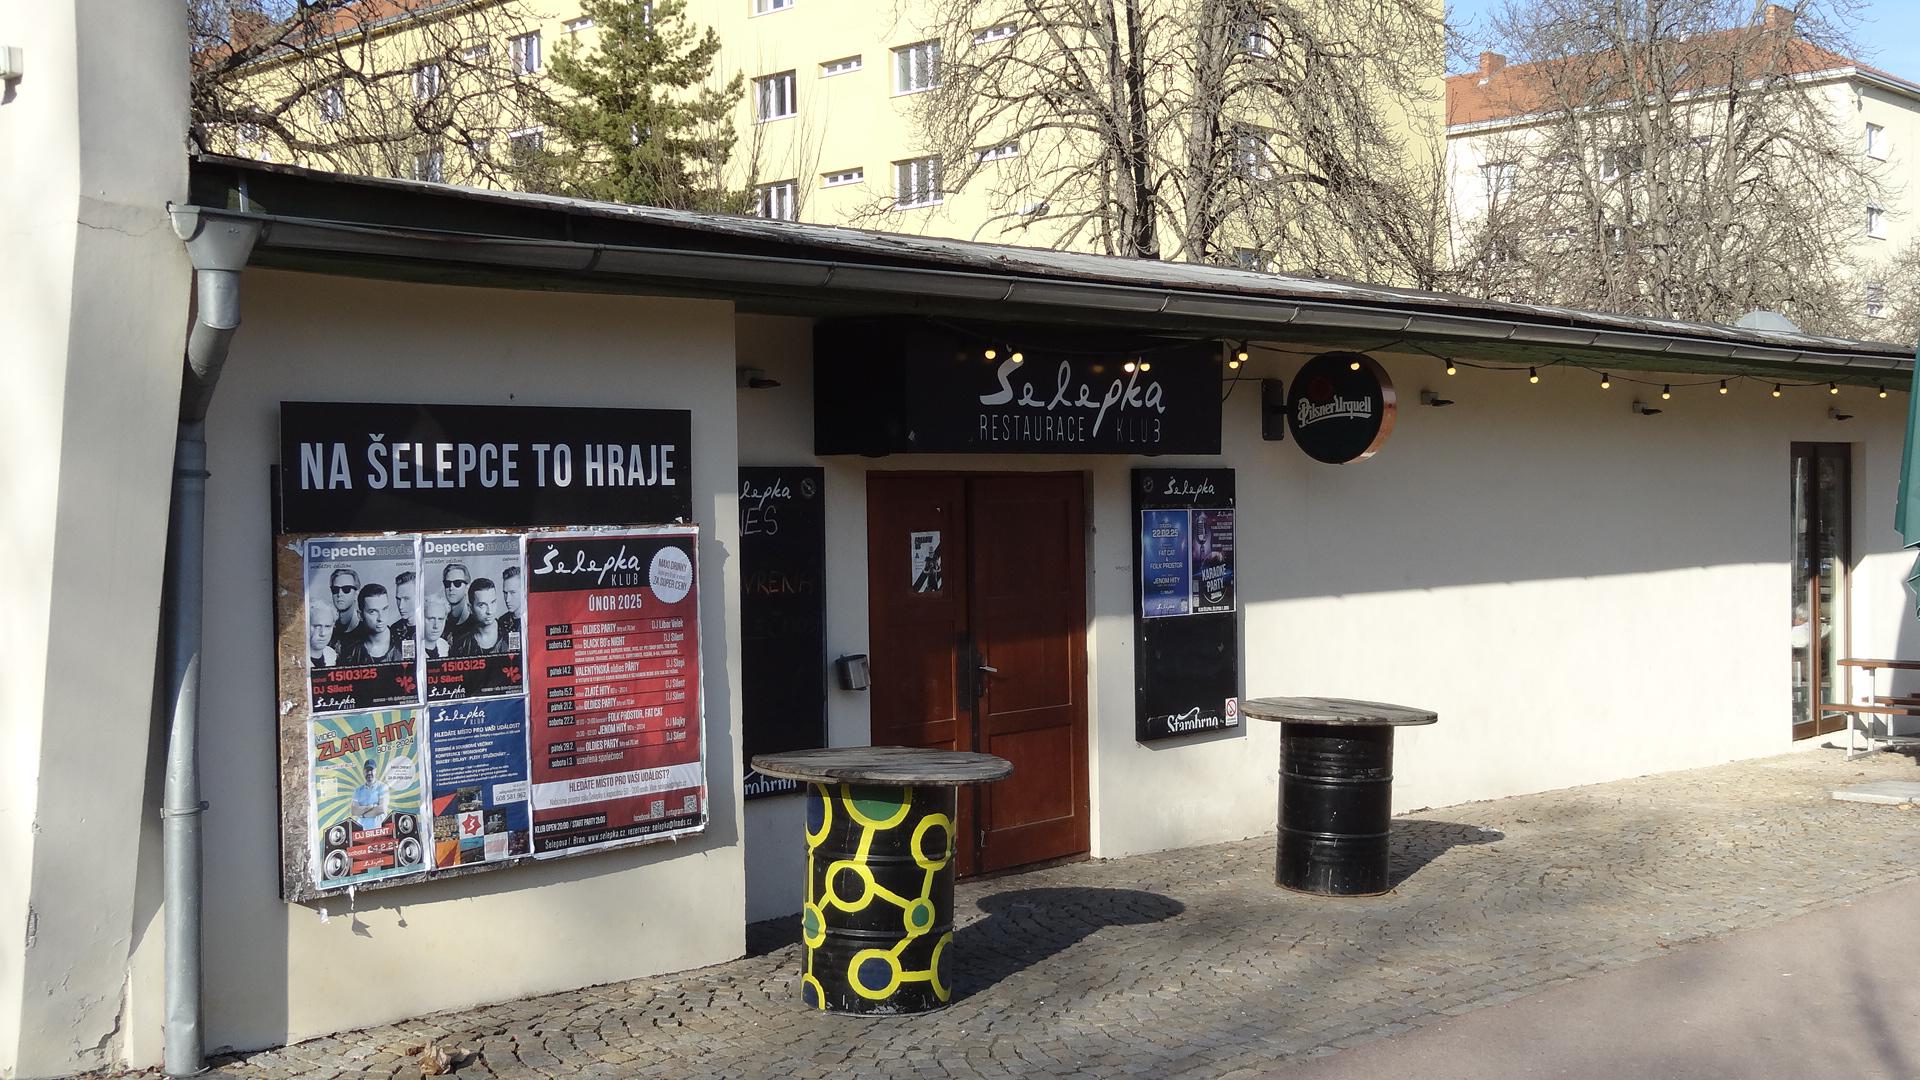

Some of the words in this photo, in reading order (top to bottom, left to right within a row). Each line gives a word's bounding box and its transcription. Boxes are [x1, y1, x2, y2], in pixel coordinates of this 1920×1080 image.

[980, 414, 1085, 442] RESTAURACE
[1117, 418, 1160, 442] KLUB
[300, 442, 352, 490] NA
[368, 433, 520, 488] ŠELEPCE
[532, 444, 572, 488] TO
[586, 444, 676, 487] HRAJE
[740, 478, 792, 508] lepka
[1164, 476, 1215, 502] Šelepka
[534, 544, 640, 585] Šelepka
[1201, 564, 1227, 581] KARAOKE
[612, 573, 638, 586] KLUB
[1206, 577, 1224, 593] PARTY
[588, 594, 616, 612] ÚNOR
[618, 594, 642, 610] 2025
[583, 624, 600, 635] OLDIES
[601, 623, 616, 633] PARTY
[652, 620, 659, 629] DJ
[583, 639, 599, 649] BLACK
[611, 637, 624, 646] NIGHT
[664, 633, 670, 641] DJ
[671, 633, 683, 641] Silent
[666, 660, 672, 668] DJ
[428, 676, 438, 684] DJ
[441, 675, 464, 683] Silent
[665, 680, 671, 688] DJ
[313, 686, 325, 694] DJ
[327, 684, 352, 693] Silent
[428, 685, 466, 698] Šelepka
[585, 684, 599, 697] ZLATÉ
[599, 685, 610, 695] HITY
[314, 695, 356, 709] Šelepka
[666, 693, 672, 701] DJ
[673, 692, 685, 700] Silent
[584, 700, 601, 710] OLDIES
[601, 698, 616, 708] PARTY
[434, 706, 485, 725] Šelepka
[608, 713, 620, 722] FOLK
[620, 710, 644, 720] PROSTOR,
[645, 708, 653, 717] FAT
[654, 707, 663, 717] CAT
[598, 724, 615, 735] JENOM
[616, 723, 626, 733] HITY
[666, 718, 671, 727] DJ
[434, 729, 456, 737] HLEDÁTE
[485, 724, 496, 732] VAŠI
[666, 732, 672, 741] DJ
[673, 731, 686, 740] Silent
[316, 727, 374, 761] ZLATÉ
[375, 717, 416, 745] HITY
[586, 741, 603, 751] OLDIES
[604, 738, 618, 749] PARTY
[569, 780, 595, 792] HLEDÁTE
[596, 777, 613, 788] MÍSTO
[615, 775, 626, 785] PRO
[627, 772, 640, 783] VAŠI
[641, 769, 670, 781] UDÁLOST?
[365, 828, 390, 838] SILENT
[535, 825, 545, 833] KLUB
[546, 823, 557, 832] OPEN
